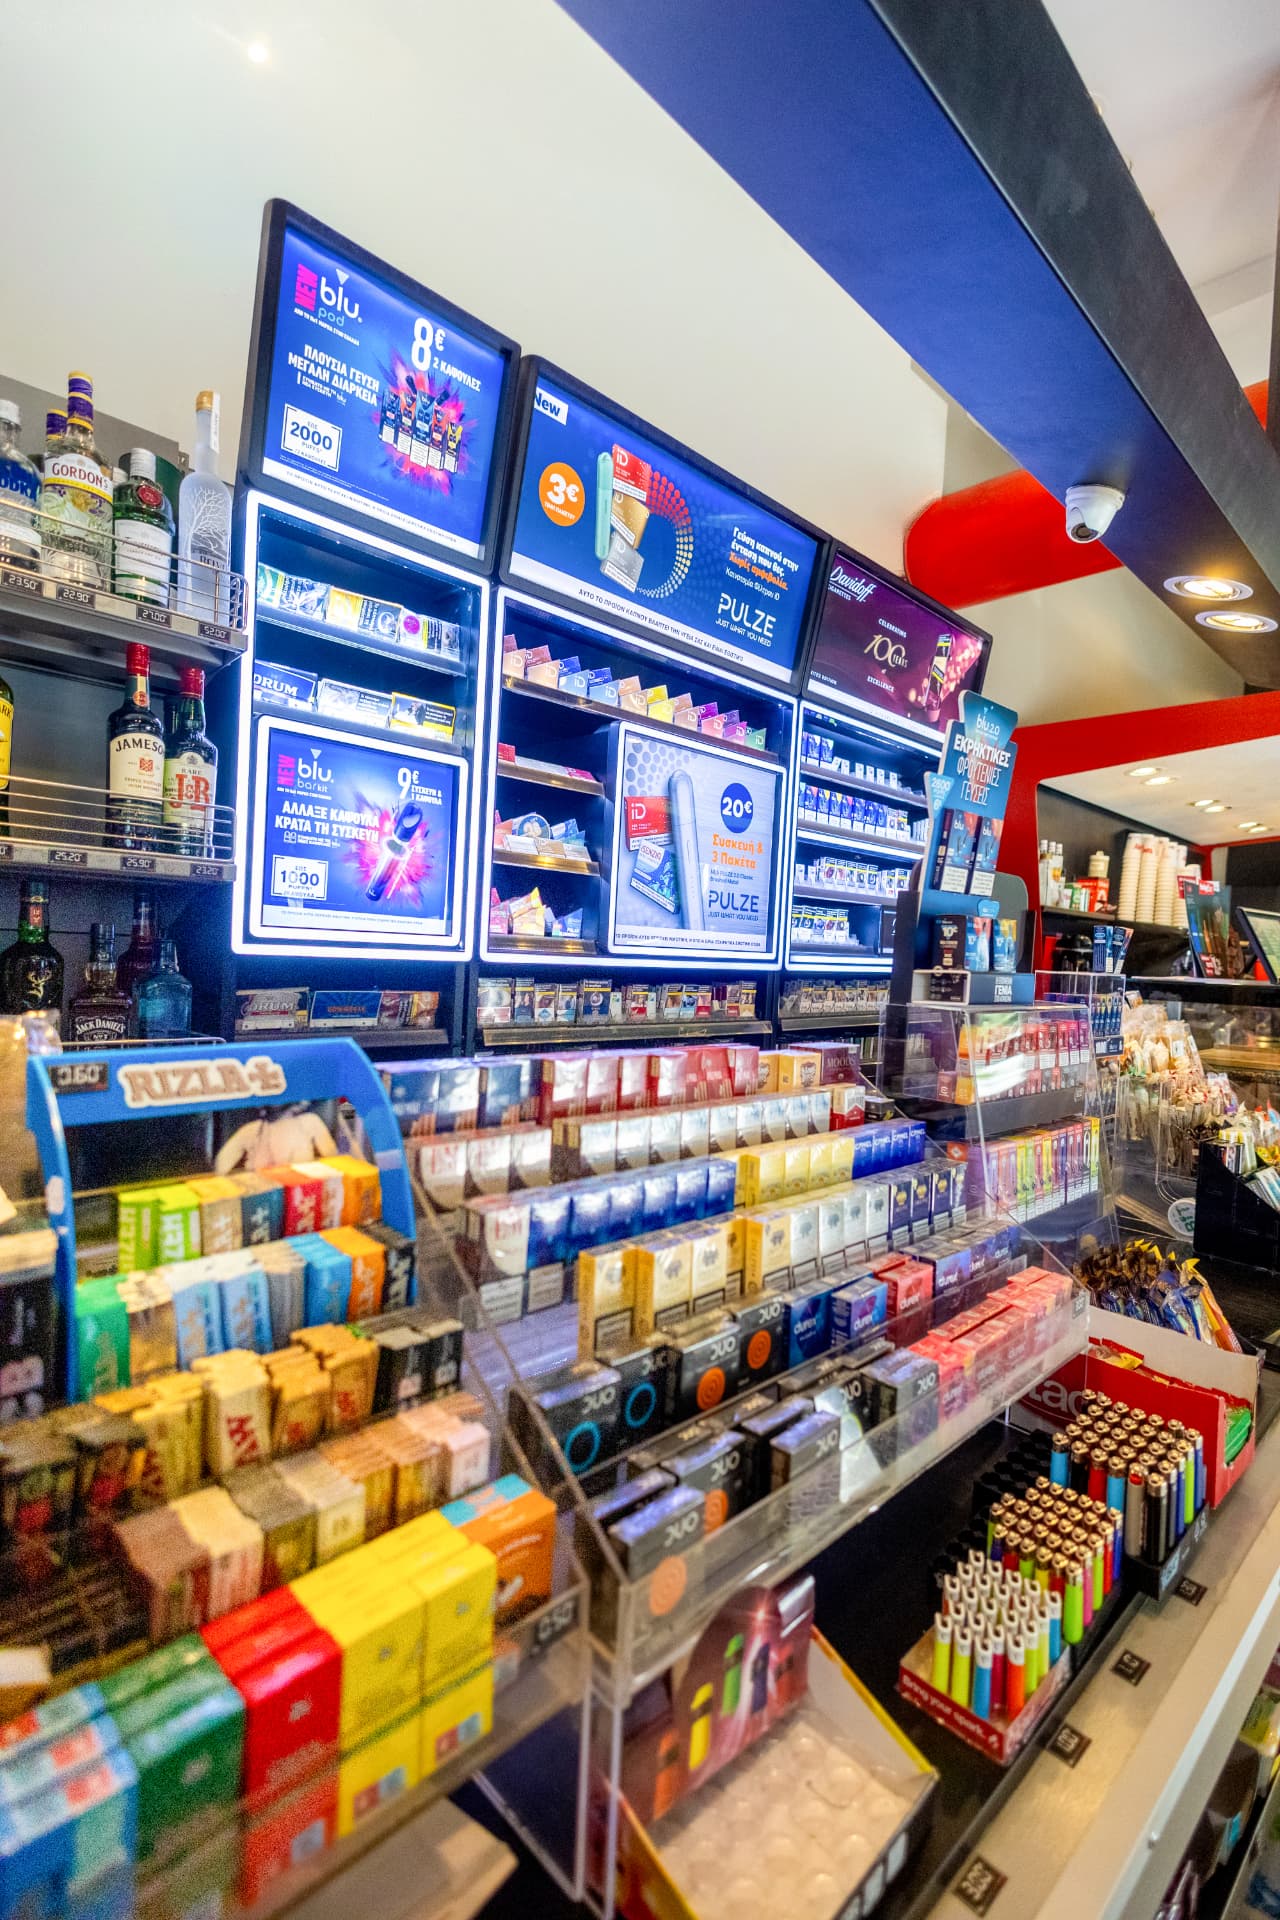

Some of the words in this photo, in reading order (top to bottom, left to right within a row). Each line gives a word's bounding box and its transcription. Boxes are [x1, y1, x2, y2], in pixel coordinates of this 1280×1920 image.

[318, 307, 345, 327] pod
[288, 352, 330, 384] ΜΕΓΑΛΗ
[332, 375, 378, 406] ΔΙΑΡΚΕΙΑ
[304, 344, 347, 377] ΠΛΟΥΣΙΑ
[347, 366, 380, 393] ΓΕΥΣΗ
[433, 357, 439, 369] 2
[440, 361, 482, 392] ΚΑΨΟΥΛΕΣ
[535, 392, 561, 417] New
[290, 421, 332, 450] 2000
[0, 476, 34, 499] ODKA
[547, 473, 580, 505] 3€
[733, 526, 756, 549] Γεύση
[579, 588, 595, 600] ΑΥΤΟ
[596, 595, 603, 604] ΤΟ
[830, 565, 877, 602] Davidoff
[717, 593, 777, 638] PULZE
[878, 618, 907, 638] CELEBRATING
[715, 617, 729, 630] JUST
[729, 623, 746, 636] WHAT
[747, 631, 757, 641] YOU
[757, 635, 772, 648] NEED
[864, 634, 906, 667] 100
[867, 675, 895, 693] EXCELLENCE
[115, 737, 164, 755] JAMESO
[954, 734, 1011, 768] ΕΚΡΗΚΤΙΚΕΣ
[277, 753, 296, 787] NEW
[169, 773, 210, 812] J&B
[297, 778, 317, 791] bar
[317, 783, 329, 793] kit
[960, 780, 990, 806] ΓΕΥΣΕΙΣ
[282, 800, 328, 820] ΑΛΛΑΞΕ
[330, 807, 380, 828] ΚΑΨΟΥΛΑ
[631, 803, 647, 820] iD
[722, 796, 752, 818] 20€
[274, 815, 312, 833] ΚΡΑΤΑ
[314, 821, 330, 836] ΤΗ
[332, 824, 379, 842] ΣΥΣΚΕΥΗ
[712, 833, 755, 855] Συσκευή
[712, 850, 718, 863] 3
[720, 852, 756, 870] Πακέτα
[281, 870, 319, 886] 1000
[708, 890, 759, 913] PULZE
[76, 1021, 95, 1035] JACK
[827, 1056, 855, 1067] MOODS
[901, 1673, 929, 1701] Bring
[930, 1695, 952, 1715] your
